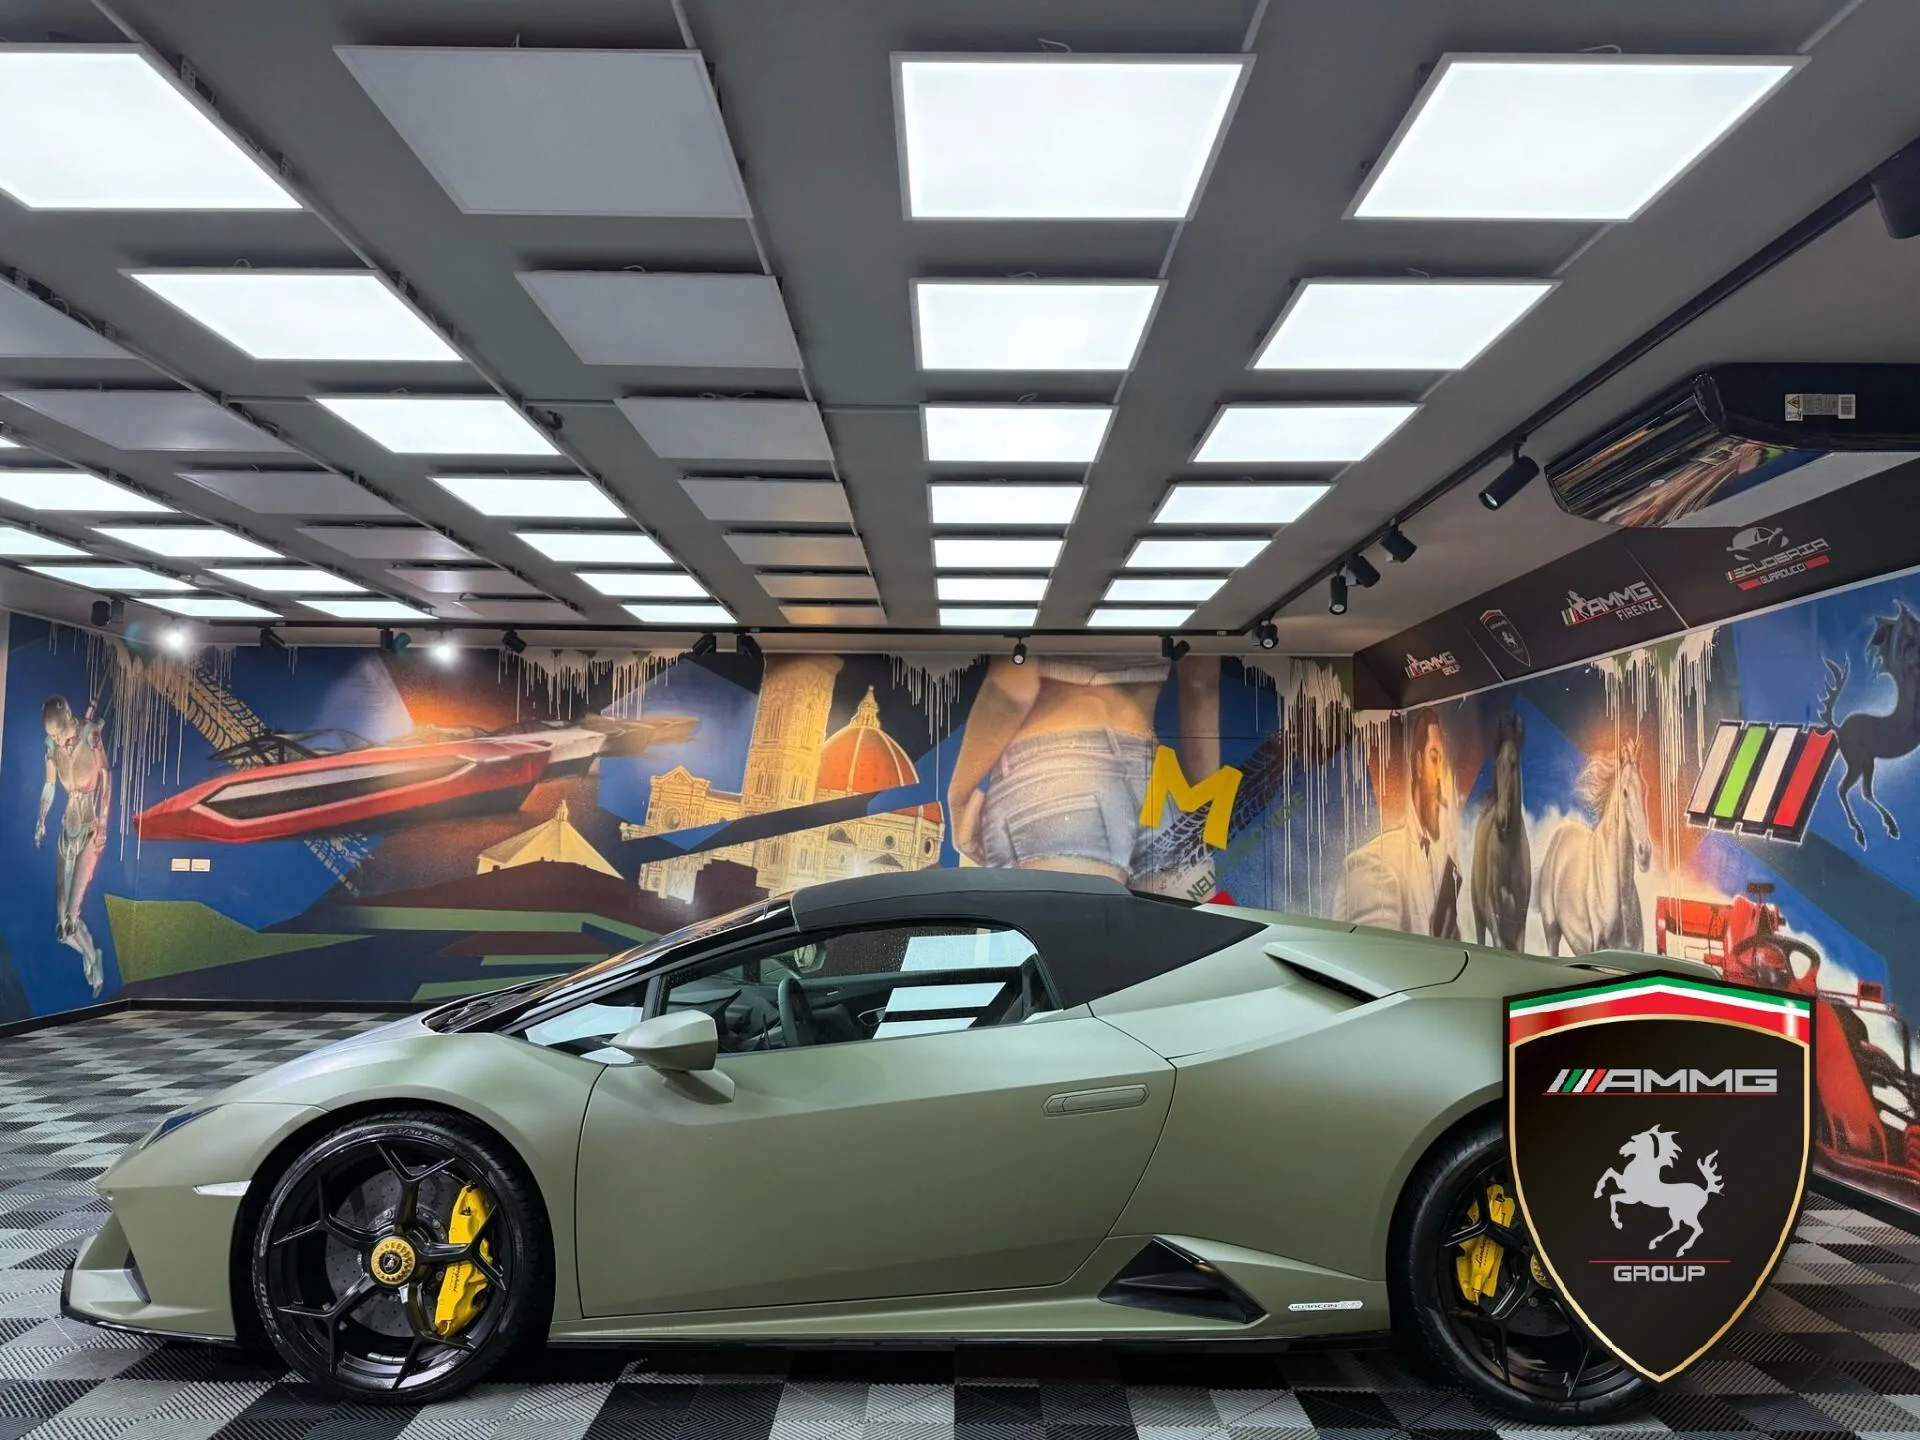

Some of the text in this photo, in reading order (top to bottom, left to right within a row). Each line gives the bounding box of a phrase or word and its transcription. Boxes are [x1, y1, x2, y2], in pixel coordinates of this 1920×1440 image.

[1733, 538, 1829, 579] SCUDERIA
[1586, 581, 1655, 617] AMMG
[1616, 598, 1664, 621] FIRENZE
